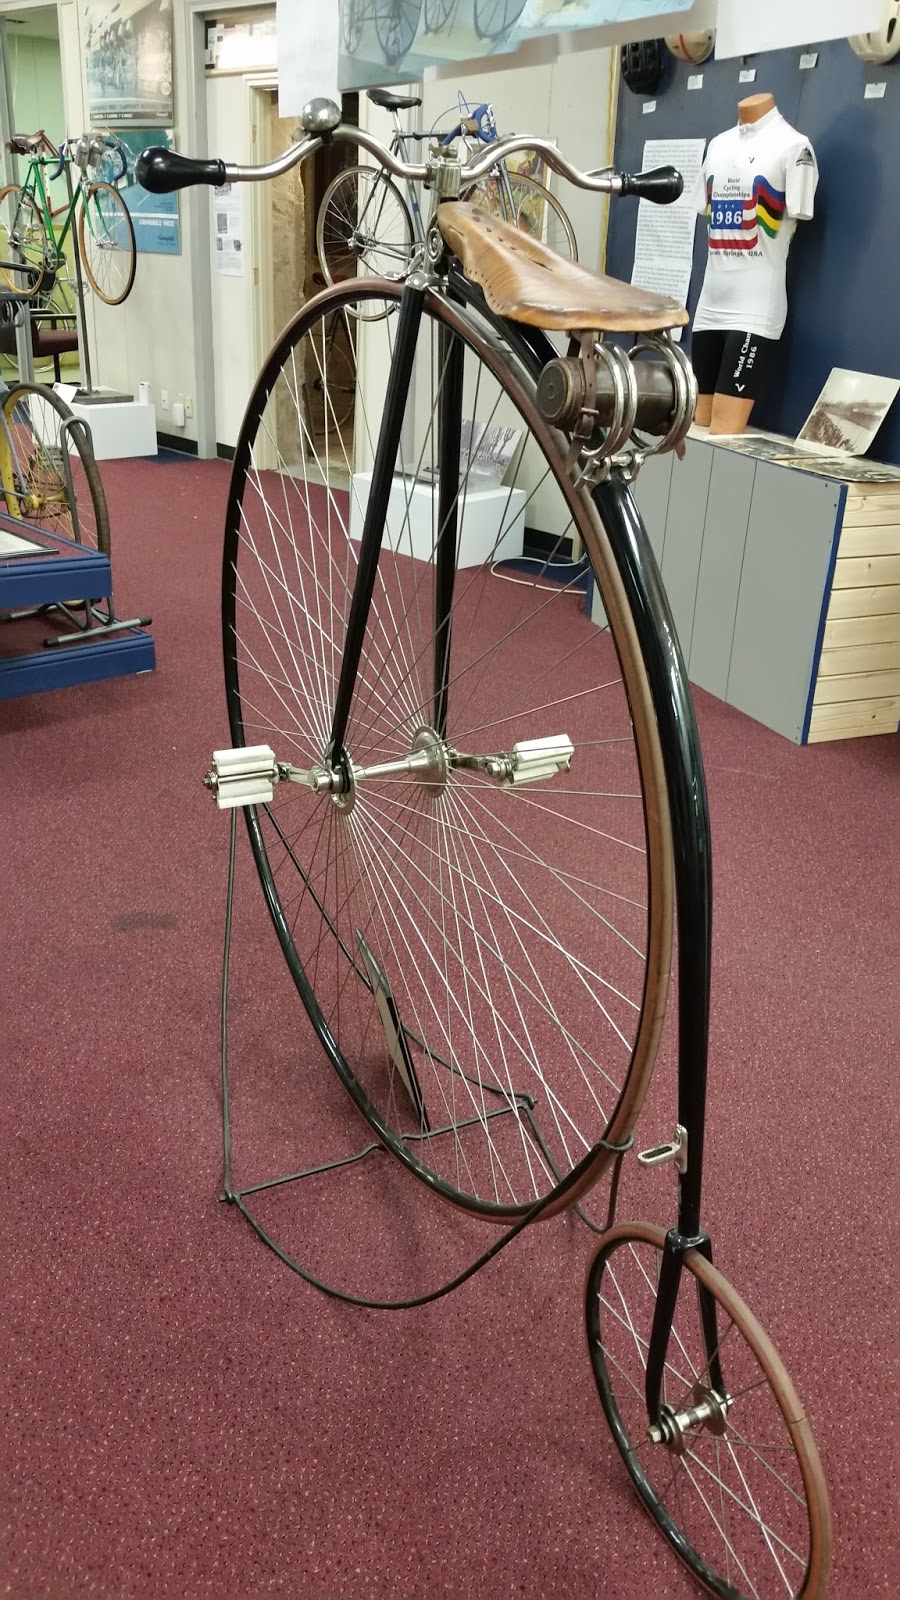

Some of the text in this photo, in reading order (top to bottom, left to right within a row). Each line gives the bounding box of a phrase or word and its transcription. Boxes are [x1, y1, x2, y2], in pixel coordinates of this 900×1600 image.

[711, 210, 742, 225] 1986
[723, 249, 745, 257] Springs,
[746, 346, 758, 368] 1986
[734, 356, 745, 378] World
